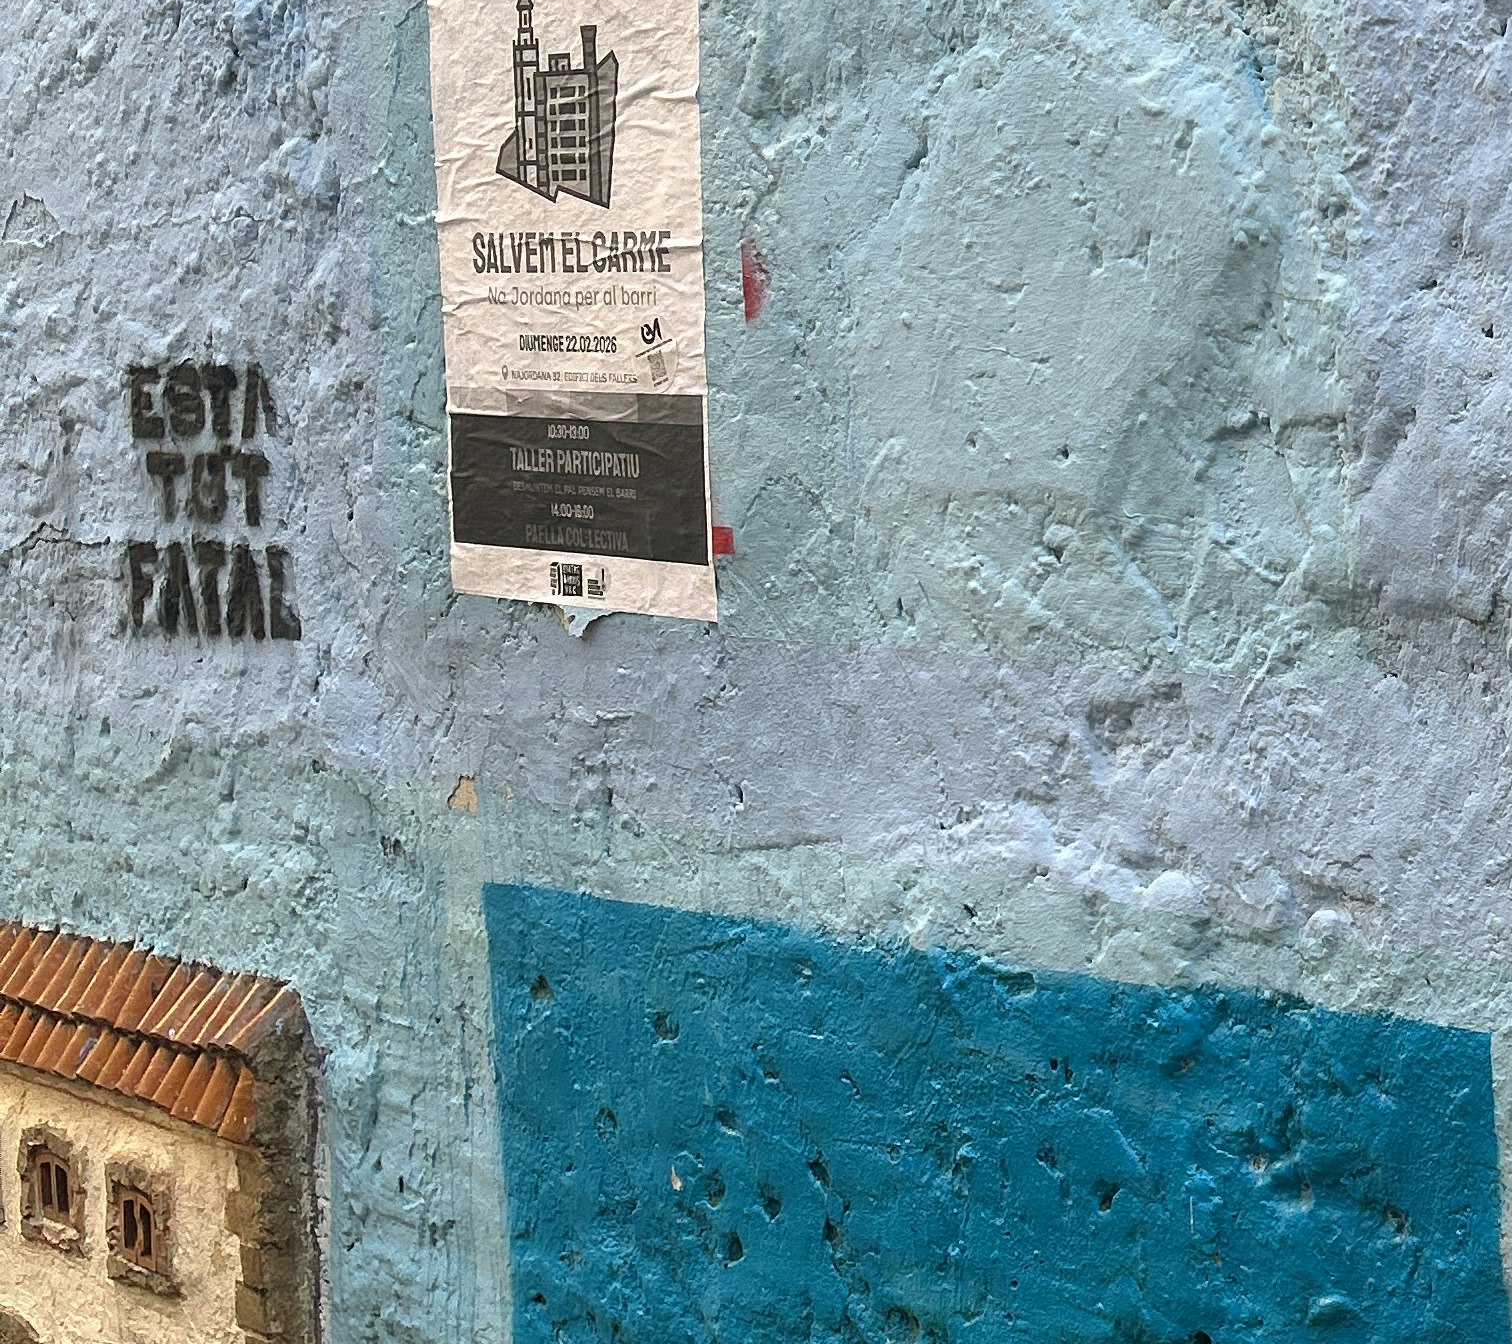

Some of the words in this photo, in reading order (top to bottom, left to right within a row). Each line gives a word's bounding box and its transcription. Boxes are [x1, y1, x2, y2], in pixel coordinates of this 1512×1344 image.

[472, 231, 556, 274] SALVEM
[560, 231, 589, 273] EL
[511, 286, 571, 305] Jordana
[575, 290, 599, 311] per
[603, 285, 617, 305] al
[621, 286, 657, 306] barri
[519, 334, 564, 352] DIUMENGE
[565, 335, 617, 353] 22.02.2026
[128, 359, 278, 438] ESTA
[510, 446, 555, 472] TALLER
[556, 449, 640, 478] PARTICIPATIU
[525, 523, 565, 545] PAELLA
[127, 540, 302, 641] FATAL
